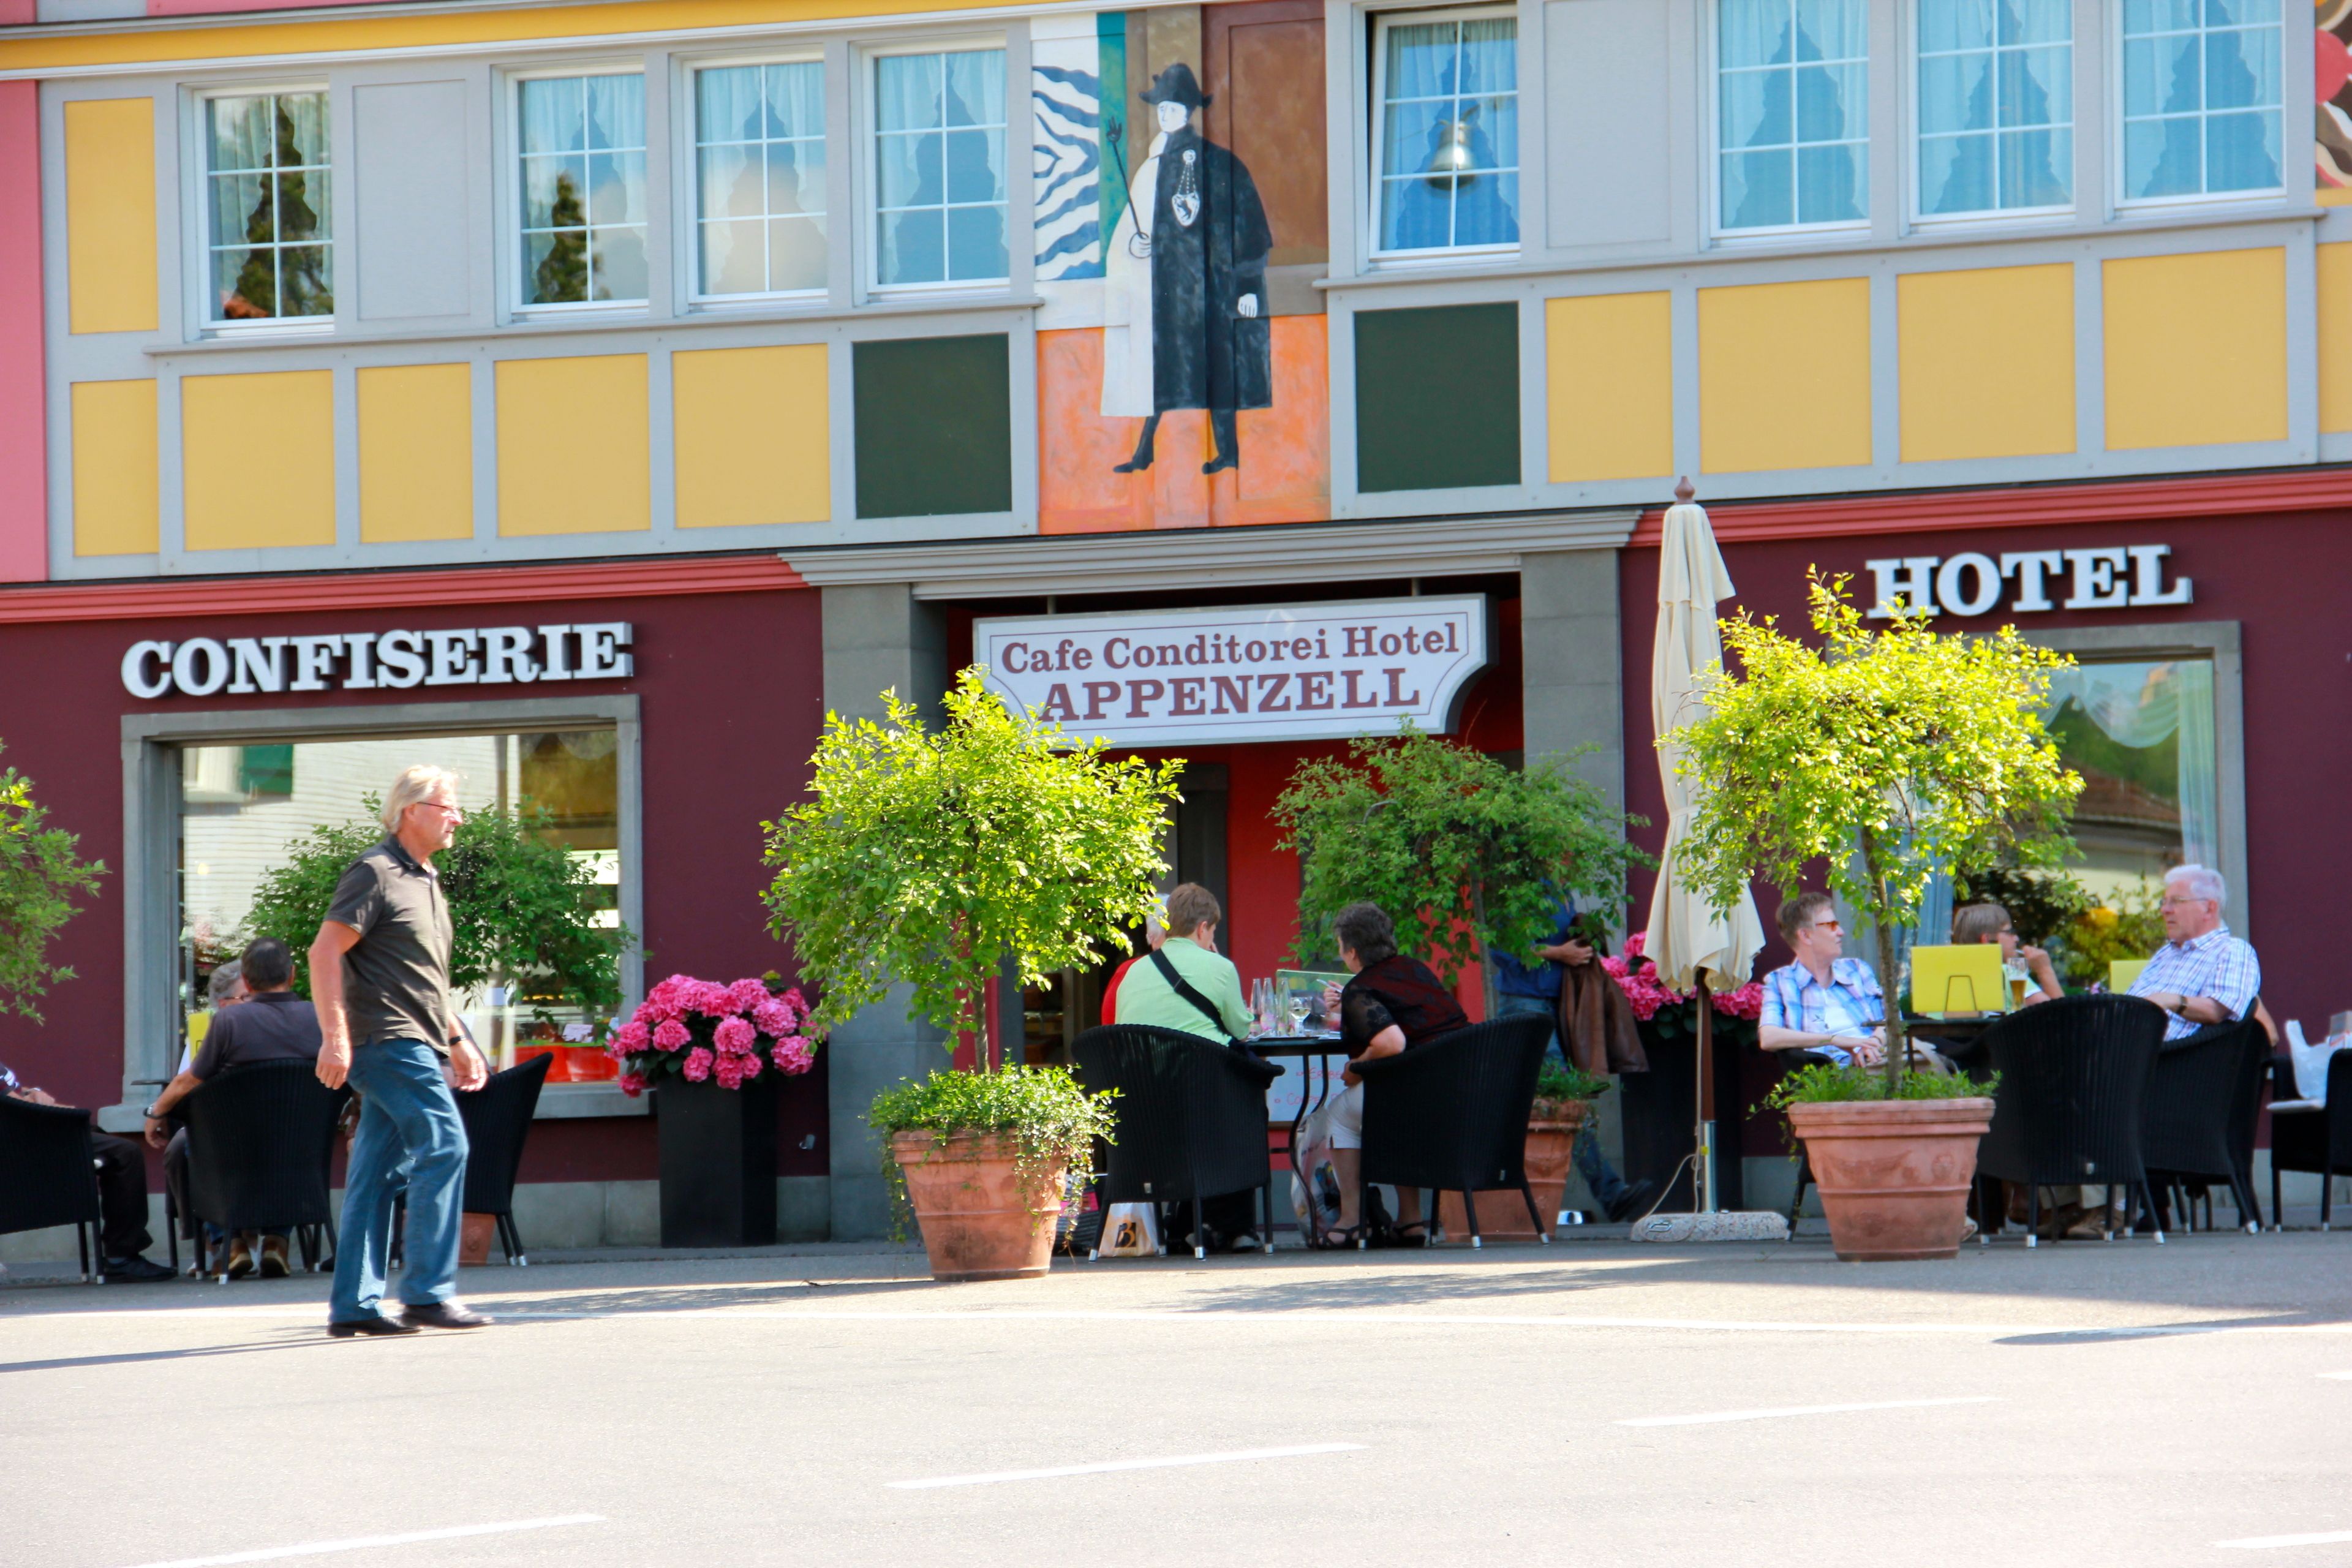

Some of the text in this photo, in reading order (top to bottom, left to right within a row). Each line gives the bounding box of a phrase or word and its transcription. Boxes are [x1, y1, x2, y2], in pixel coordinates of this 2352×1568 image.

[1865, 544, 2193, 619] HOTEL
[121, 620, 633, 699] CONFISERIE
[1001, 622, 1460, 674] Cafe Conditorei Hotel
[1038, 668, 1420, 723] APPENZELL
